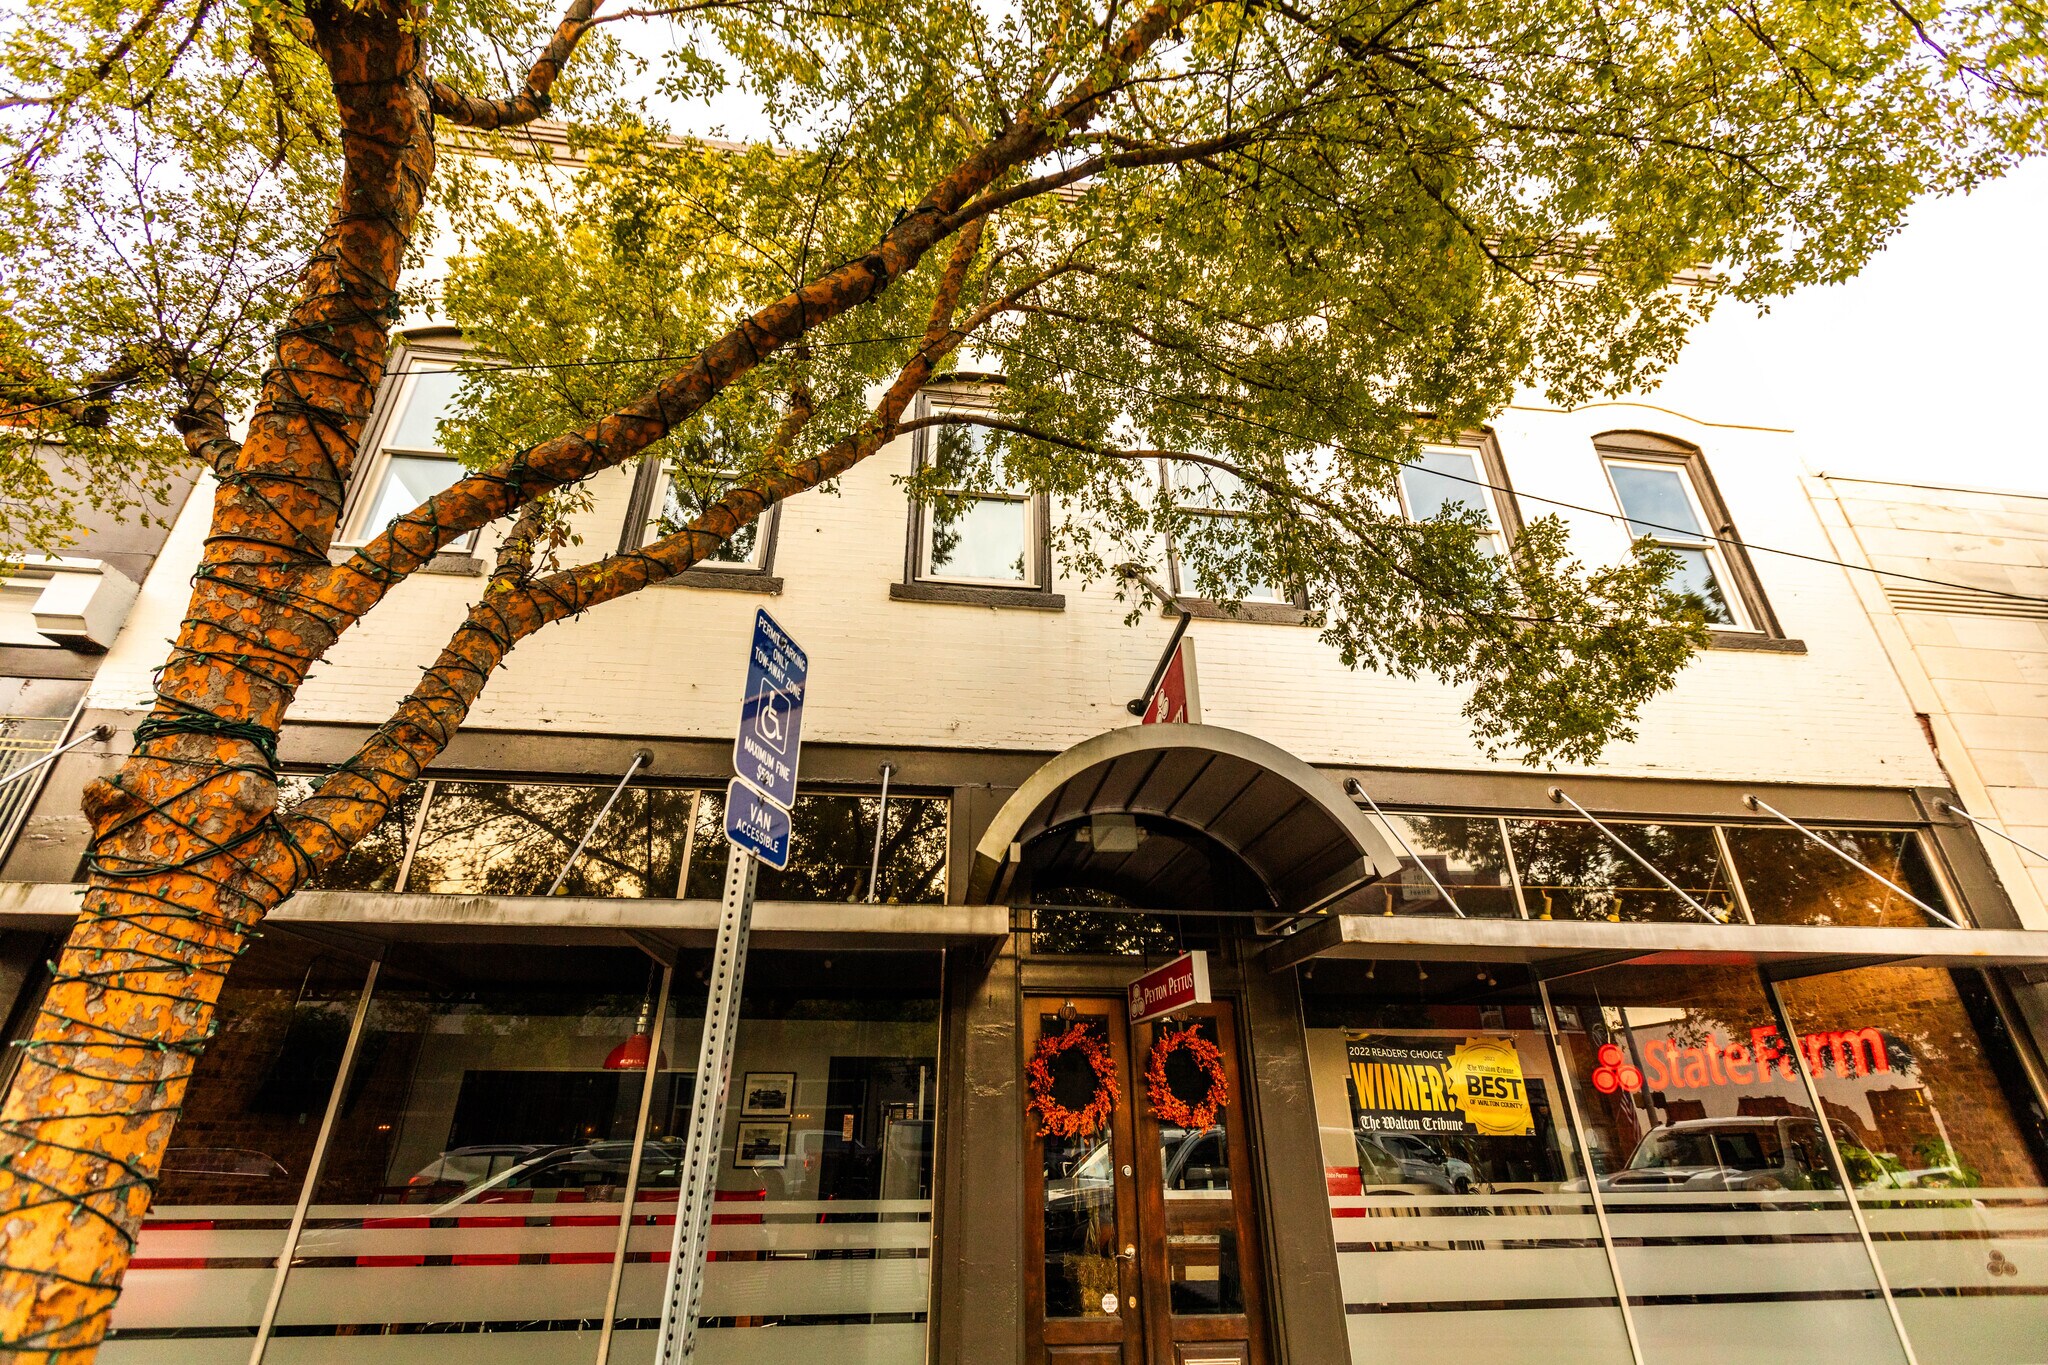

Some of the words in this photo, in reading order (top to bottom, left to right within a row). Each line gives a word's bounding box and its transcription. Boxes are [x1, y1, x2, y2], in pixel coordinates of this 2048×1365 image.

[758, 615, 780, 646] PERMIT
[780, 637, 806, 672] PARKING
[755, 646, 785, 684] TOW-AWAY
[785, 677, 802, 701] ZONE
[773, 648, 789, 671] ONLY
[744, 736, 775, 770] MAXIMUM
[775, 760, 790, 782] FINE
[750, 803, 772, 832] VAN
[735, 818, 780, 853] ACCESSIBLE
[1144, 984, 1168, 1005] PEYTON
[1168, 972, 1193, 996] PETTUS
[1349, 1046, 1371, 1057] 2022
[1371, 1048, 1408, 1058] READERS'
[1410, 1049, 1444, 1060] CHOICE
[1466, 1064, 1478, 1072] The
[1478, 1065, 1496, 1073] Walton
[1496, 1066, 1515, 1074] Tribune
[1465, 1074, 1522, 1100] BEST
[1360, 1115, 1381, 1132] The
[1381, 1115, 1421, 1130] Walton
[1422, 1116, 1464, 1131] Tribune
